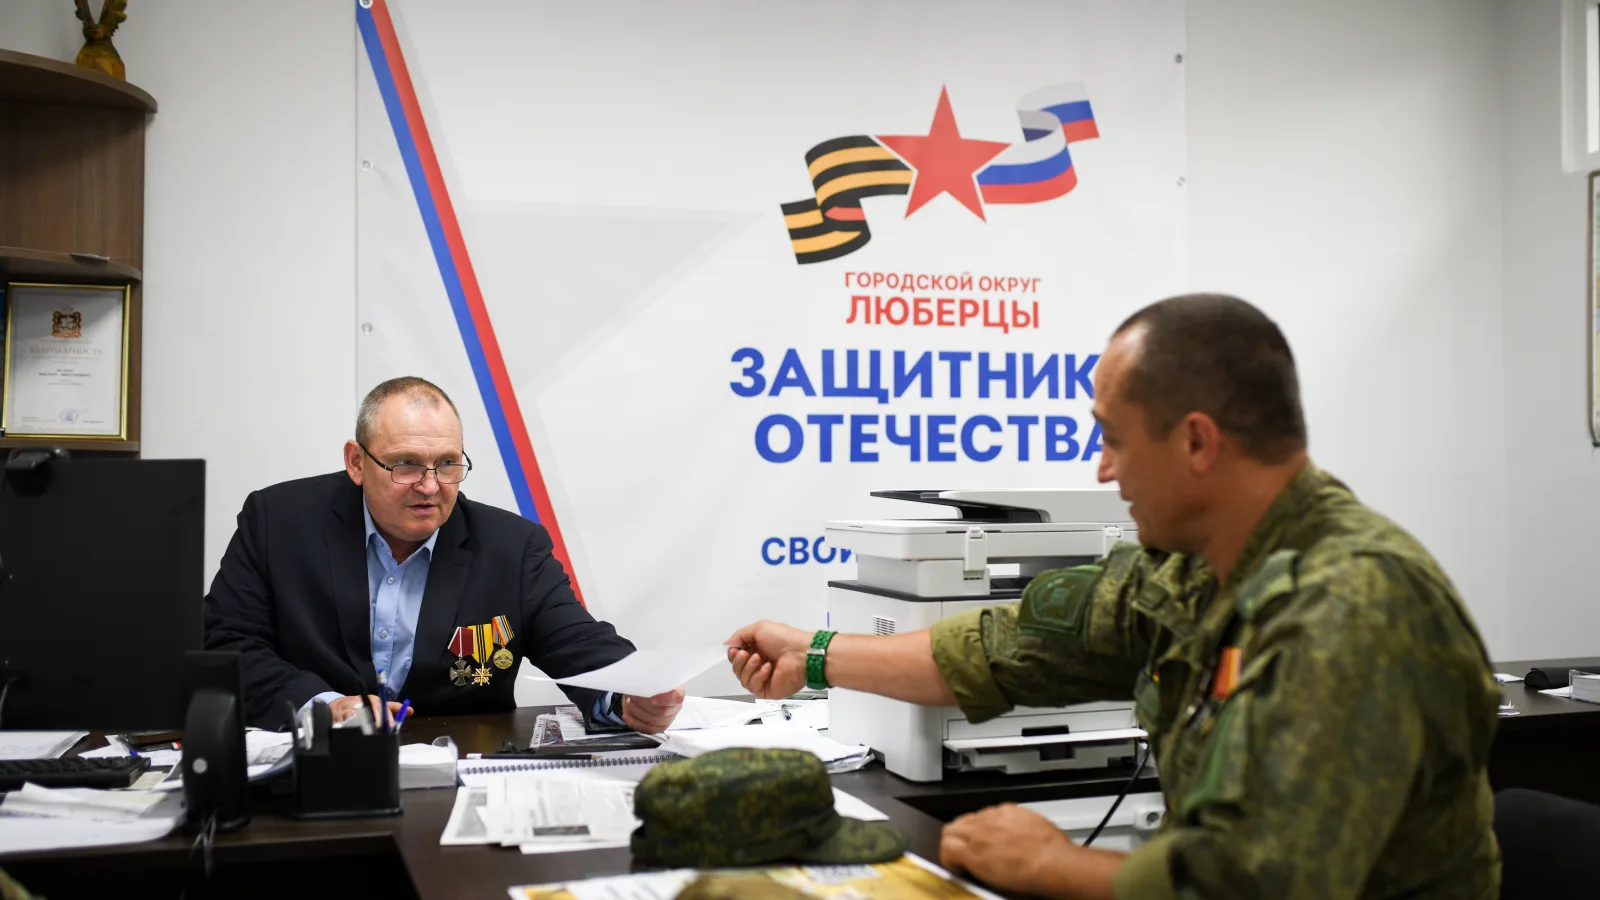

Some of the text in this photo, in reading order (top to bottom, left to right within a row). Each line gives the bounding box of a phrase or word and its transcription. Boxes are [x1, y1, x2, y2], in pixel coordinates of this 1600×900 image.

[844, 270, 1042, 293] ГОРОДСКОЙ ОКРУГ
[846, 295, 1040, 334] ЛЮБЕРЦЫ
[729, 347, 1101, 404] ЗАЩИТНИК
